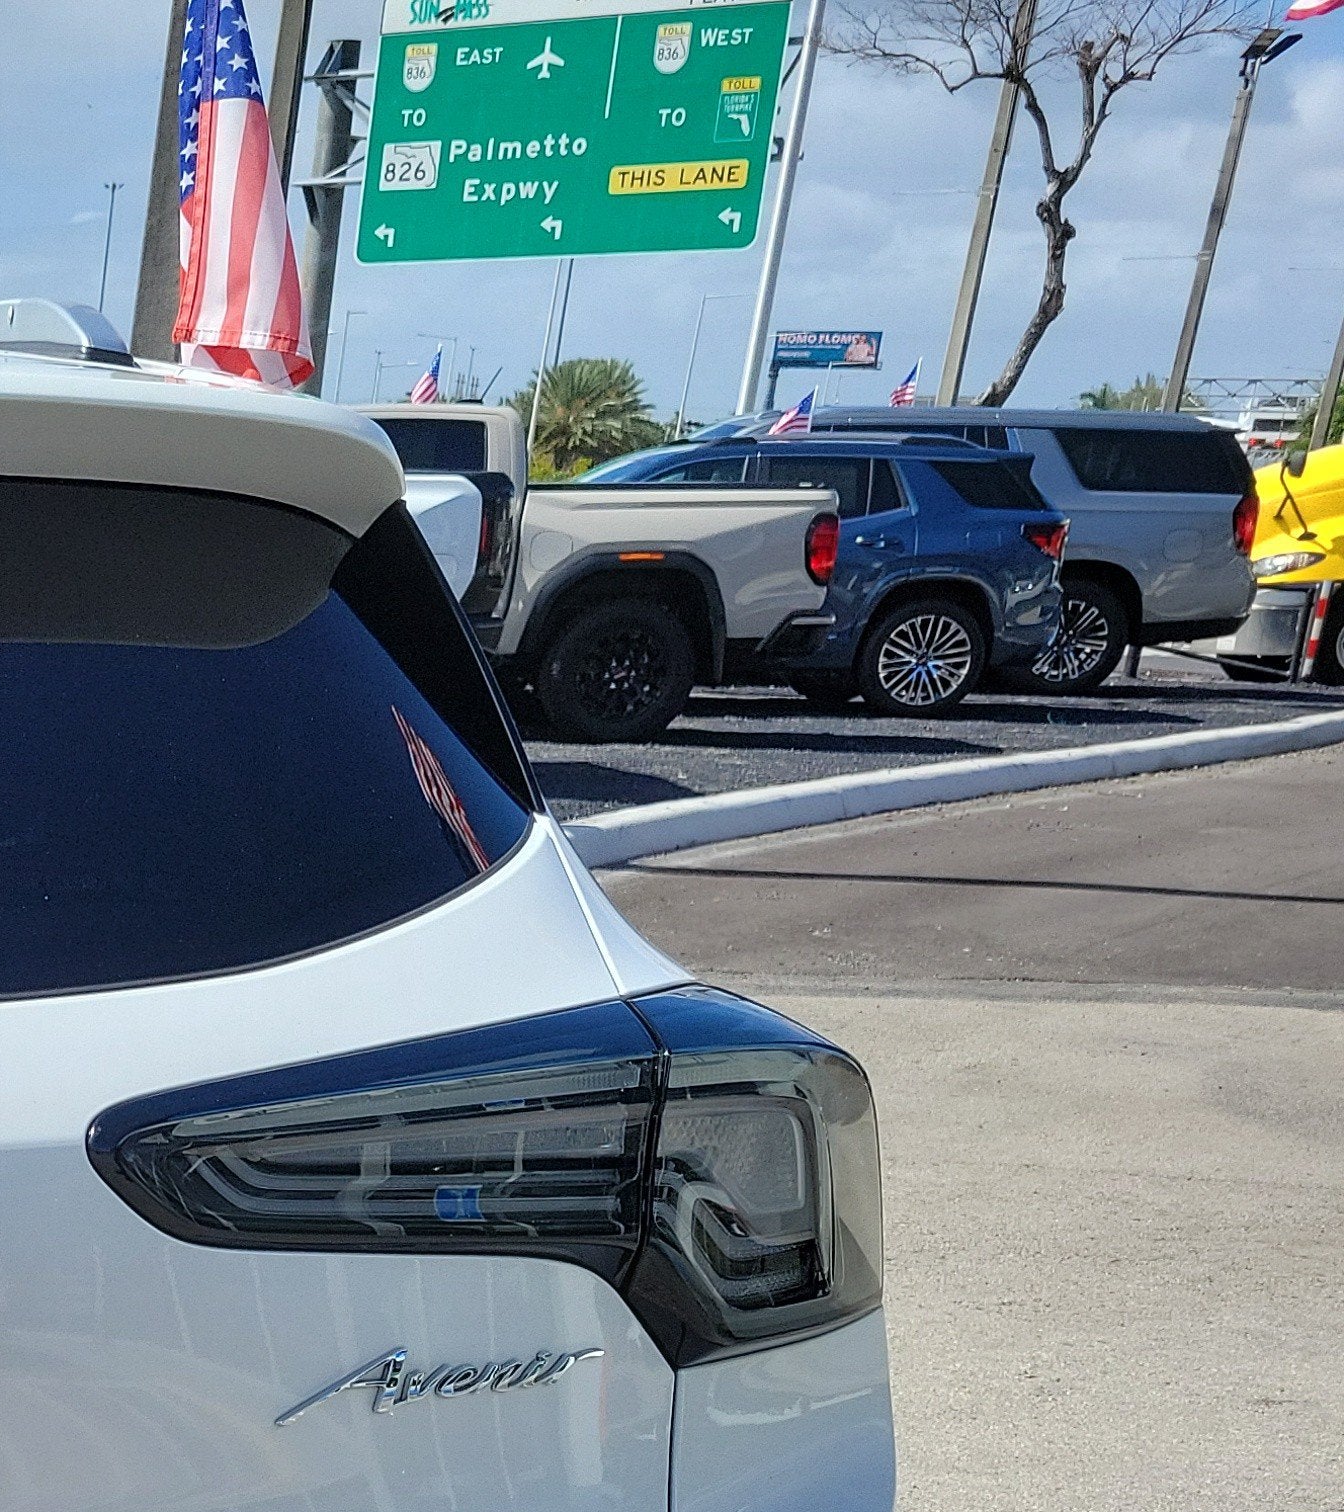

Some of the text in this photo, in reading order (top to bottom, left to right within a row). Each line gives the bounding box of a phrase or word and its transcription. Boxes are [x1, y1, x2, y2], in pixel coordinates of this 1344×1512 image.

[662, 26, 687, 36] TOLL
[700, 27, 754, 48] WEST
[410, 46, 434, 57] TOLL
[455, 46, 504, 66] EAST
[657, 47, 680, 62] 836
[406, 66, 427, 80] 836
[727, 79, 756, 91] TOLL
[401, 107, 427, 128] TO
[658, 107, 687, 128] TO
[448, 132, 588, 164] Palmetto
[384, 161, 427, 183] 826
[617, 165, 741, 189] THIS LANE
[462, 177, 560, 206] Expwy
[274, 1346, 606, 1427] Avenir
